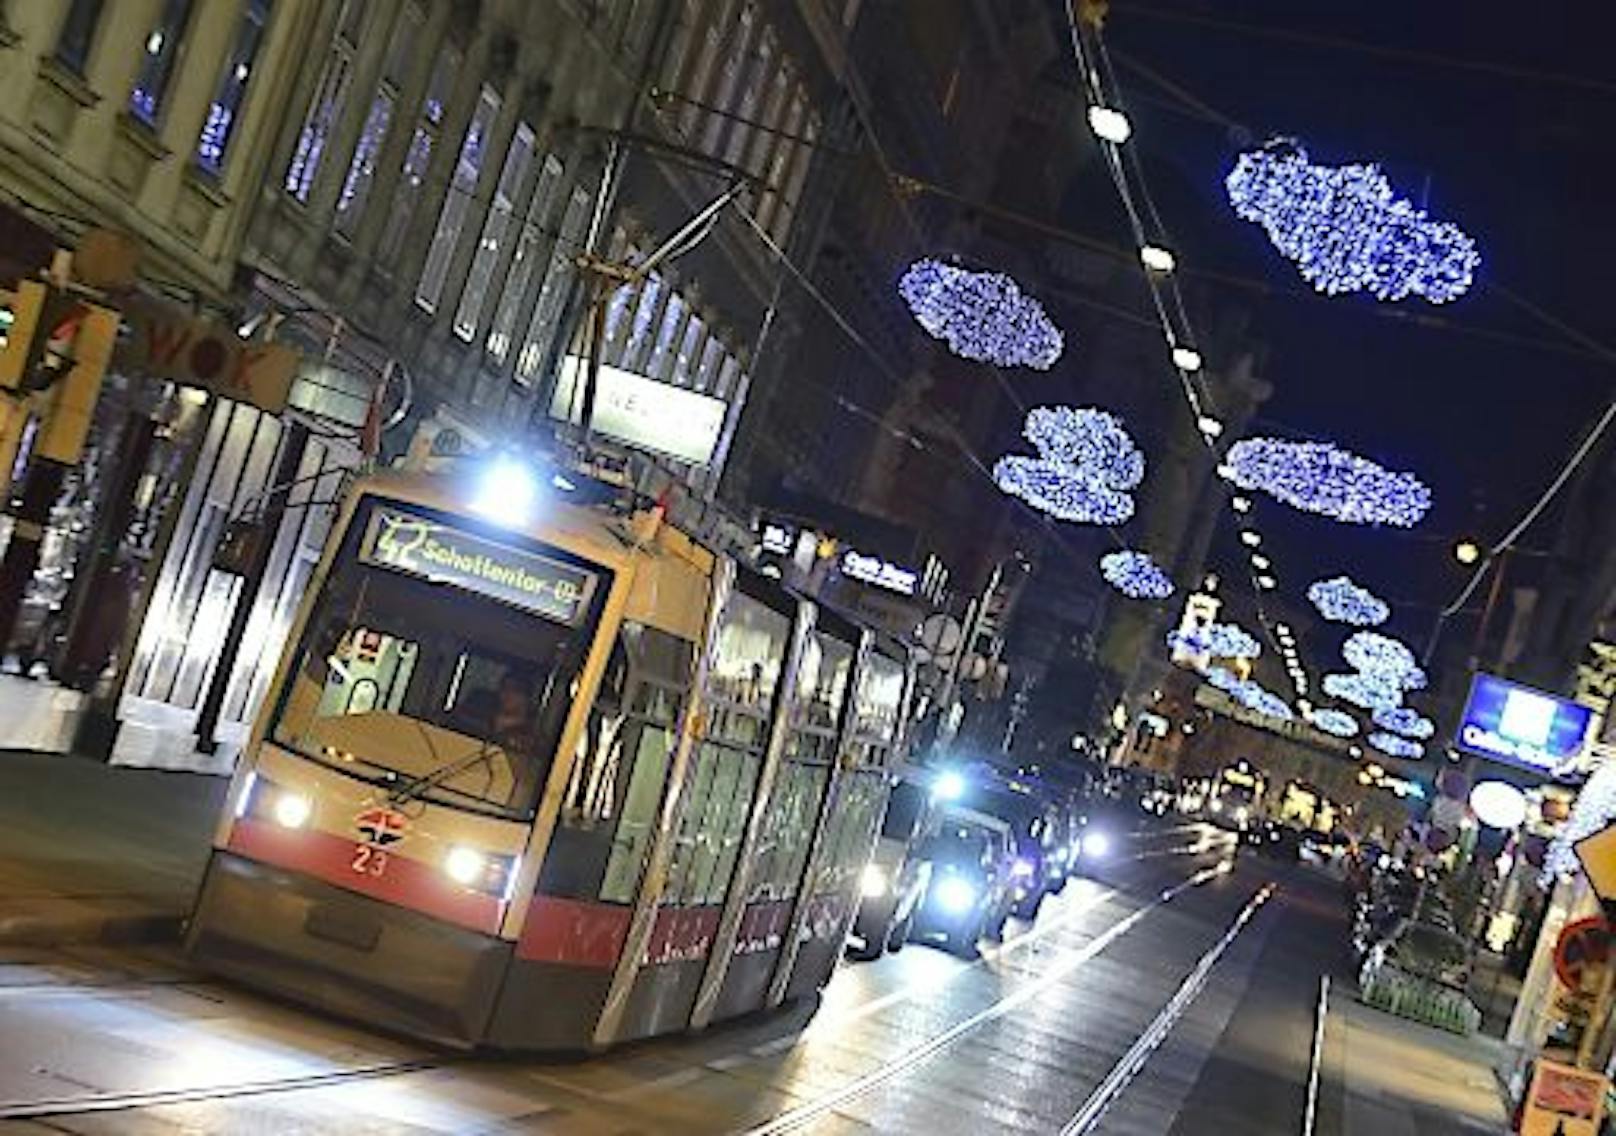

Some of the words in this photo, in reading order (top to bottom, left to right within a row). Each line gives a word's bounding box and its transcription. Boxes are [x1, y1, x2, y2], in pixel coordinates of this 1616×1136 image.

[147, 319, 267, 389] WOK
[377, 514, 427, 568] 42
[352, 845, 388, 876] 23
